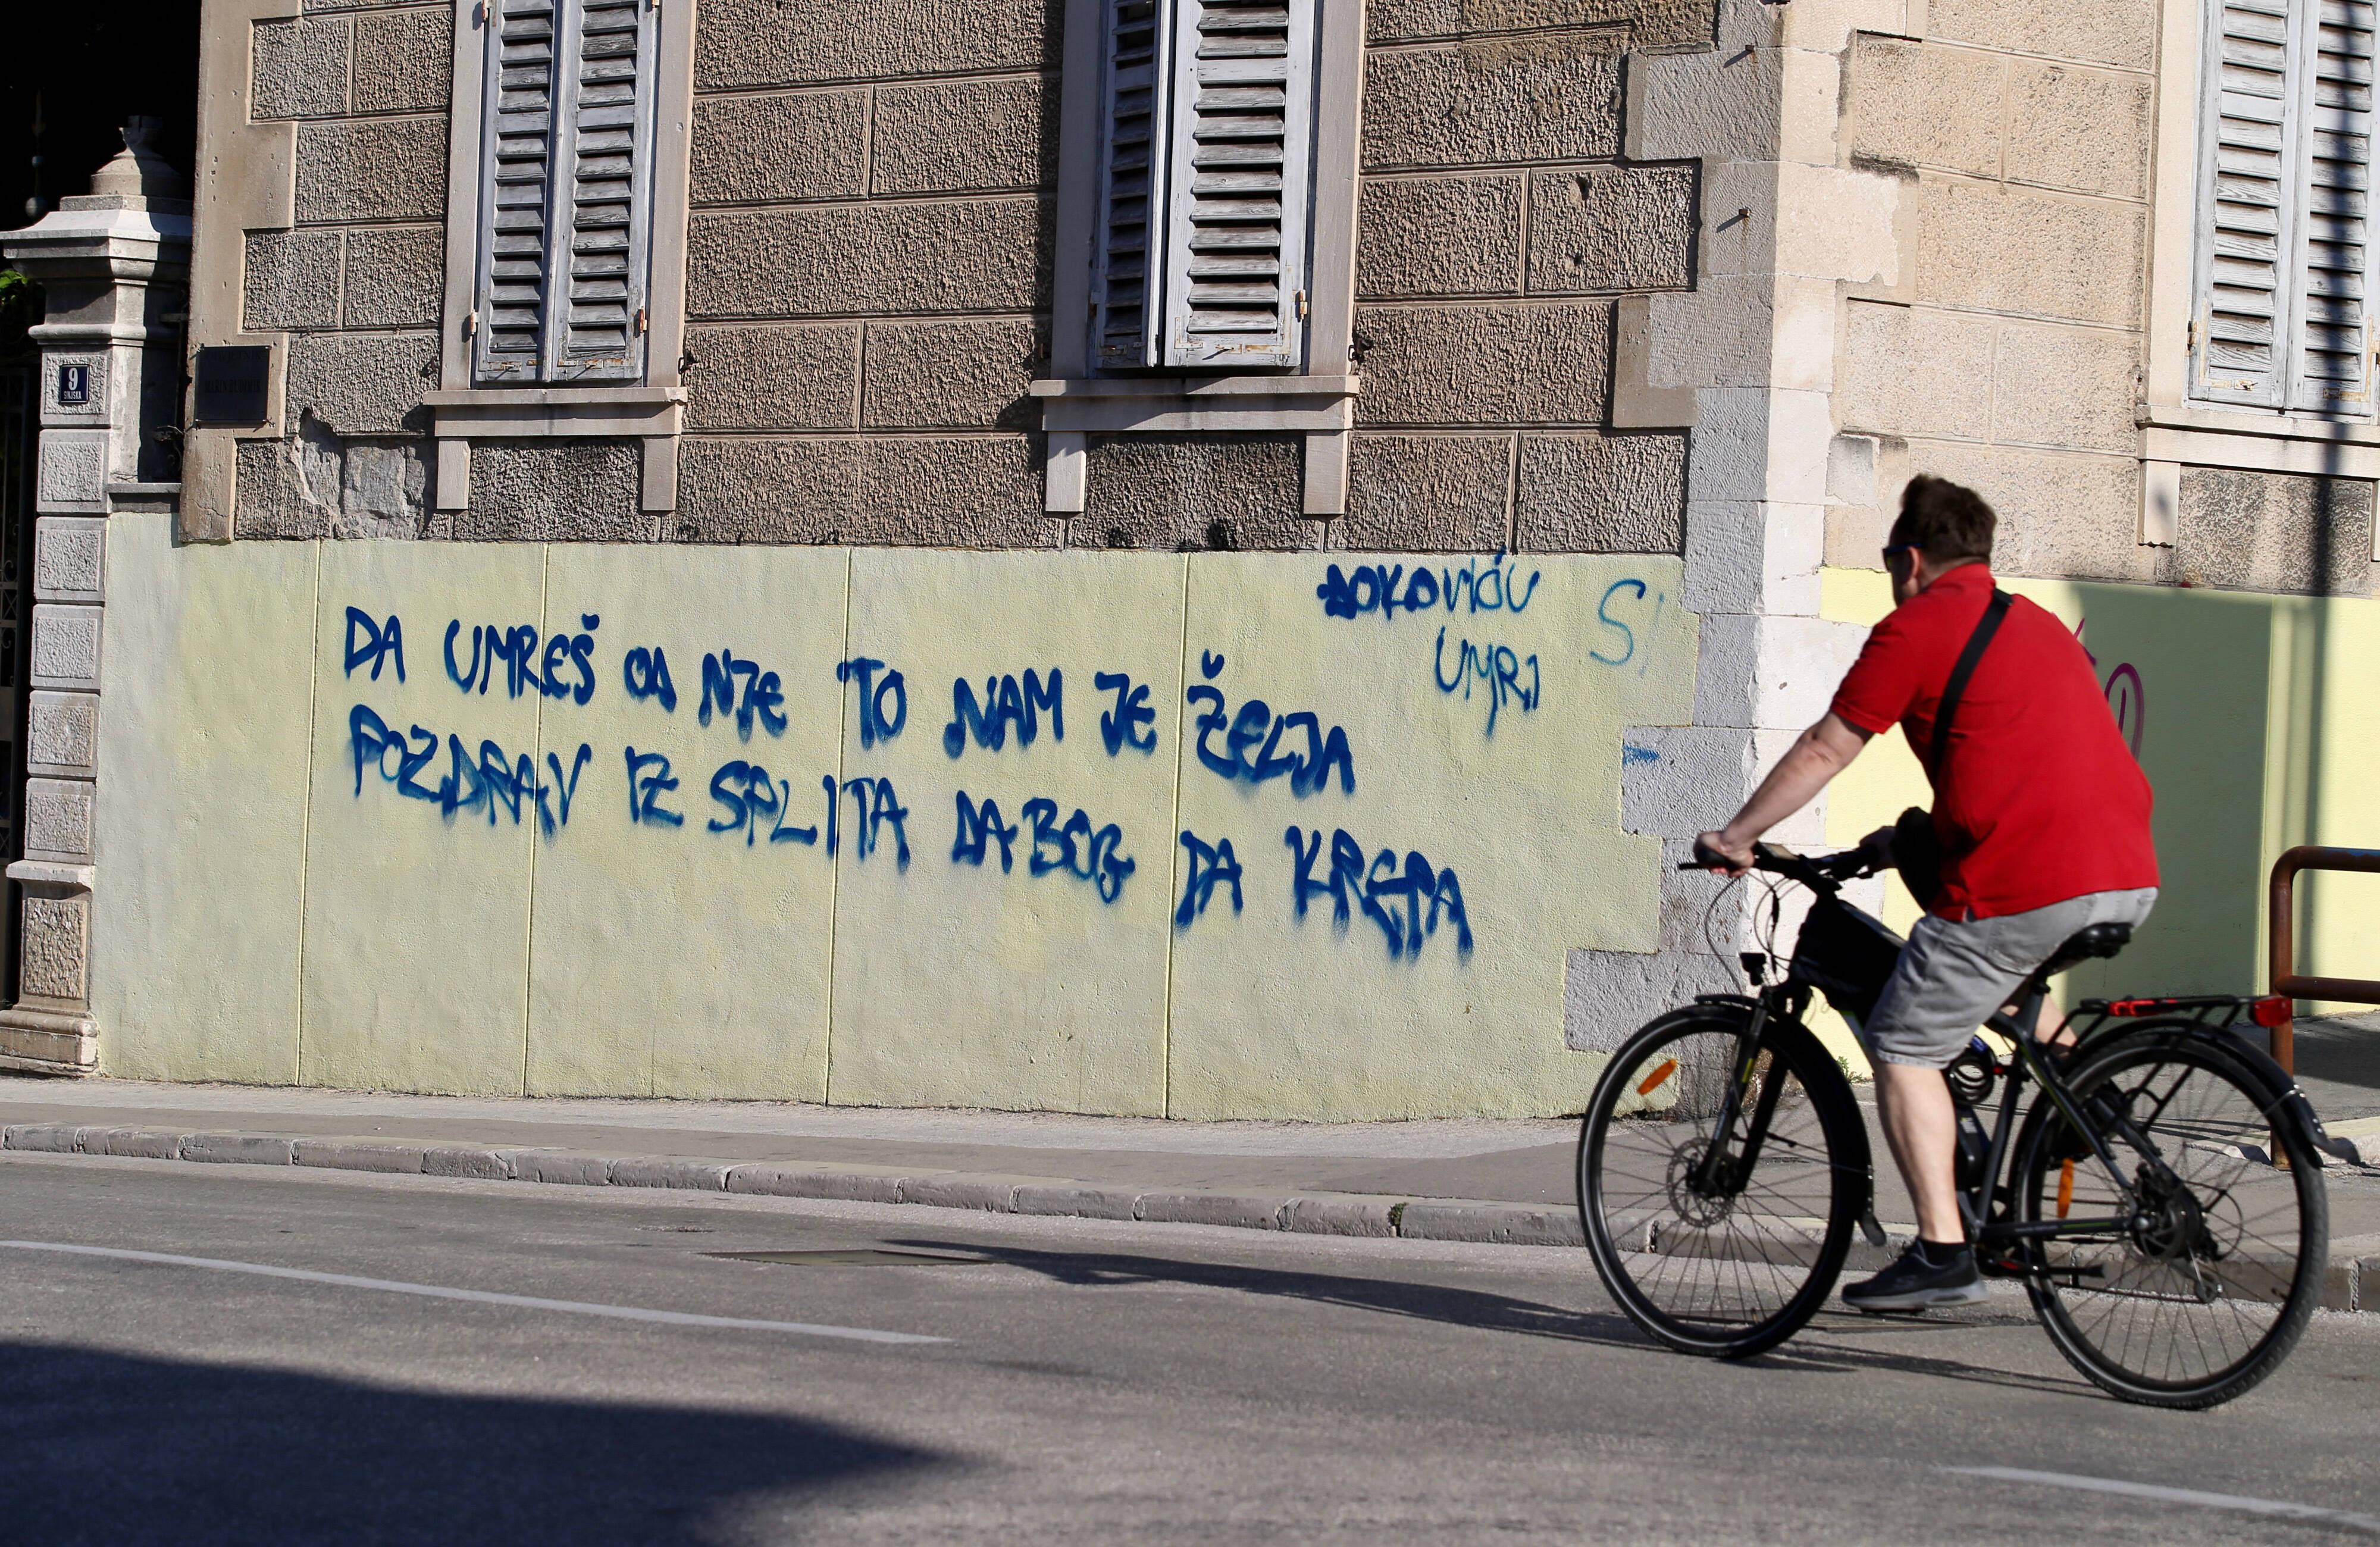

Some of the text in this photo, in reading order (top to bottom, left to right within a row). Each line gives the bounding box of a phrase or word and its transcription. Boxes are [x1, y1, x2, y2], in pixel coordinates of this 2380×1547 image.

[64, 391, 82, 400] SINJSKA
[68, 367, 78, 391] 9
[344, 606, 405, 684] DA
[836, 656, 907, 750] TO
[943, 668, 1064, 759] NAM
[1094, 671, 1157, 756] JE
[349, 704, 592, 836] POZDRAV
[625, 746, 684, 828] IZ
[707, 760, 910, 873] SPLITA
[1174, 829, 1243, 931] DA
